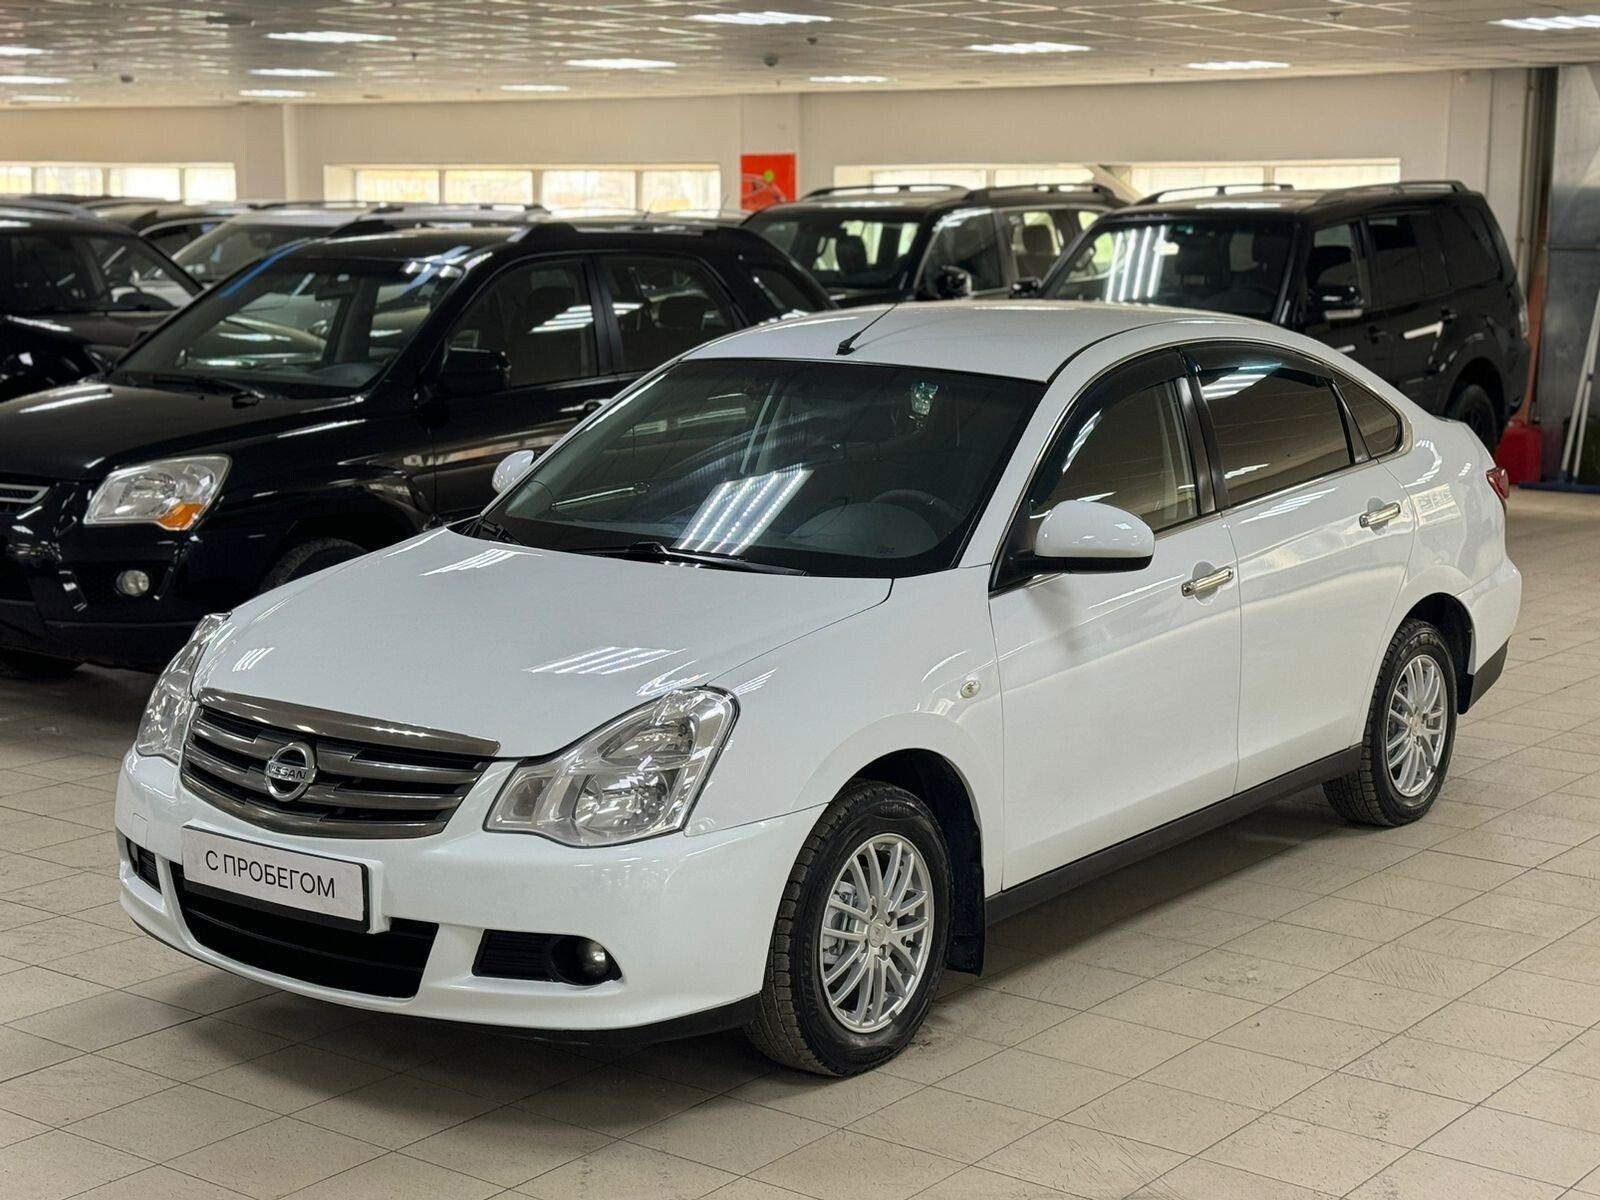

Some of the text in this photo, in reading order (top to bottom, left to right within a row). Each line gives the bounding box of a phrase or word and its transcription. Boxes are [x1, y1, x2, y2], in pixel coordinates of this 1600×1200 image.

[268, 764, 307, 780] NISSAN
[205, 850, 336, 898] С ПРОБЕГОМ
